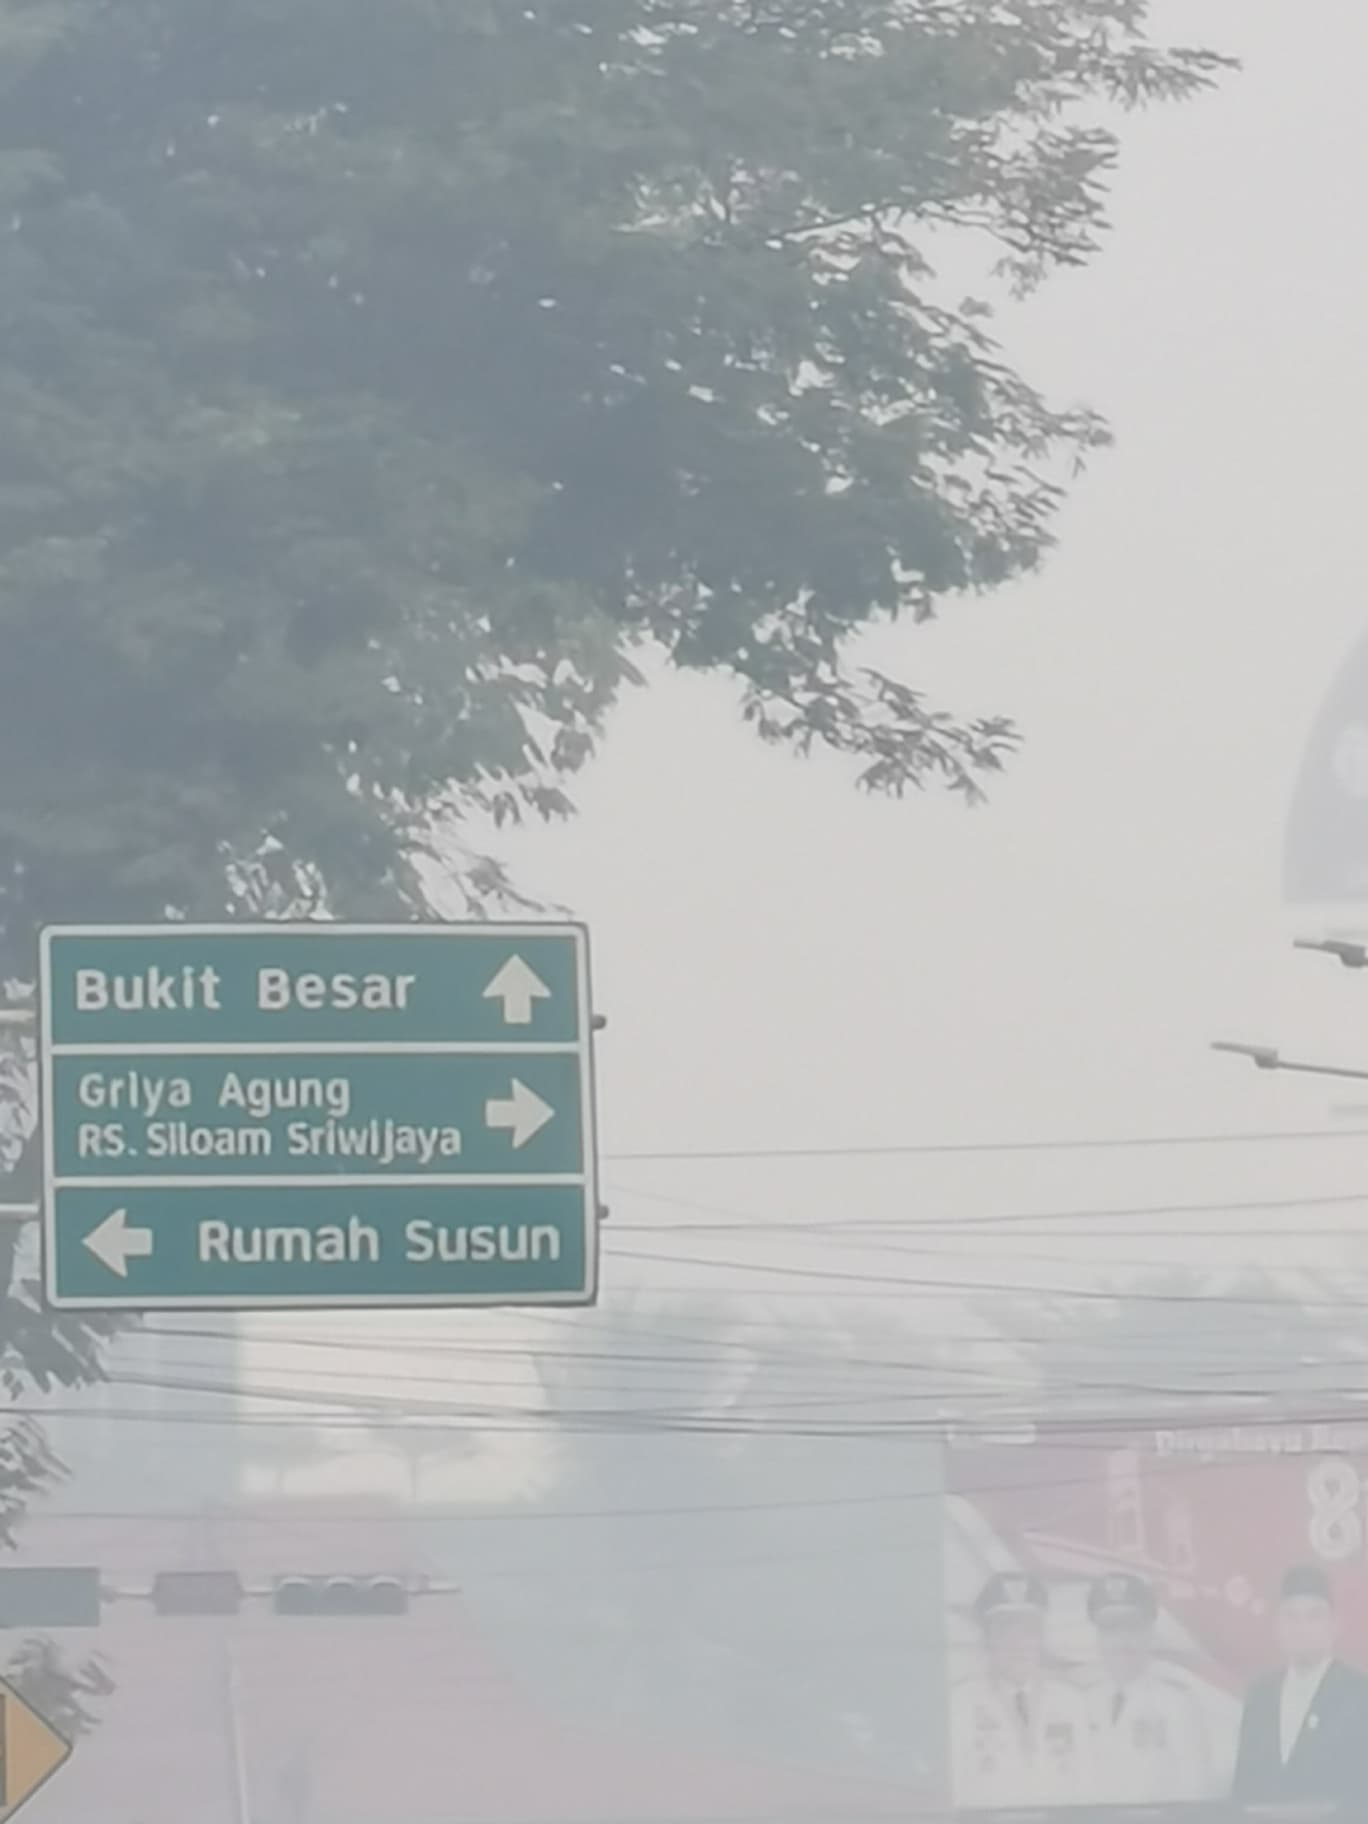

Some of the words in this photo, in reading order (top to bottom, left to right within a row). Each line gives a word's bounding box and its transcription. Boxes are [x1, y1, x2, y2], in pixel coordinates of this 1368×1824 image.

[75, 966, 221, 1011] Bukit
[257, 968, 416, 1010] Besar
[79, 1071, 192, 1117] Griya
[218, 1073, 350, 1117] Agung
[78, 1123, 138, 1157] RS.
[147, 1121, 271, 1157] Siloam
[288, 1120, 461, 1164] Sriwijaya
[199, 1215, 379, 1262] Rumah
[405, 1220, 560, 1262] Susun
